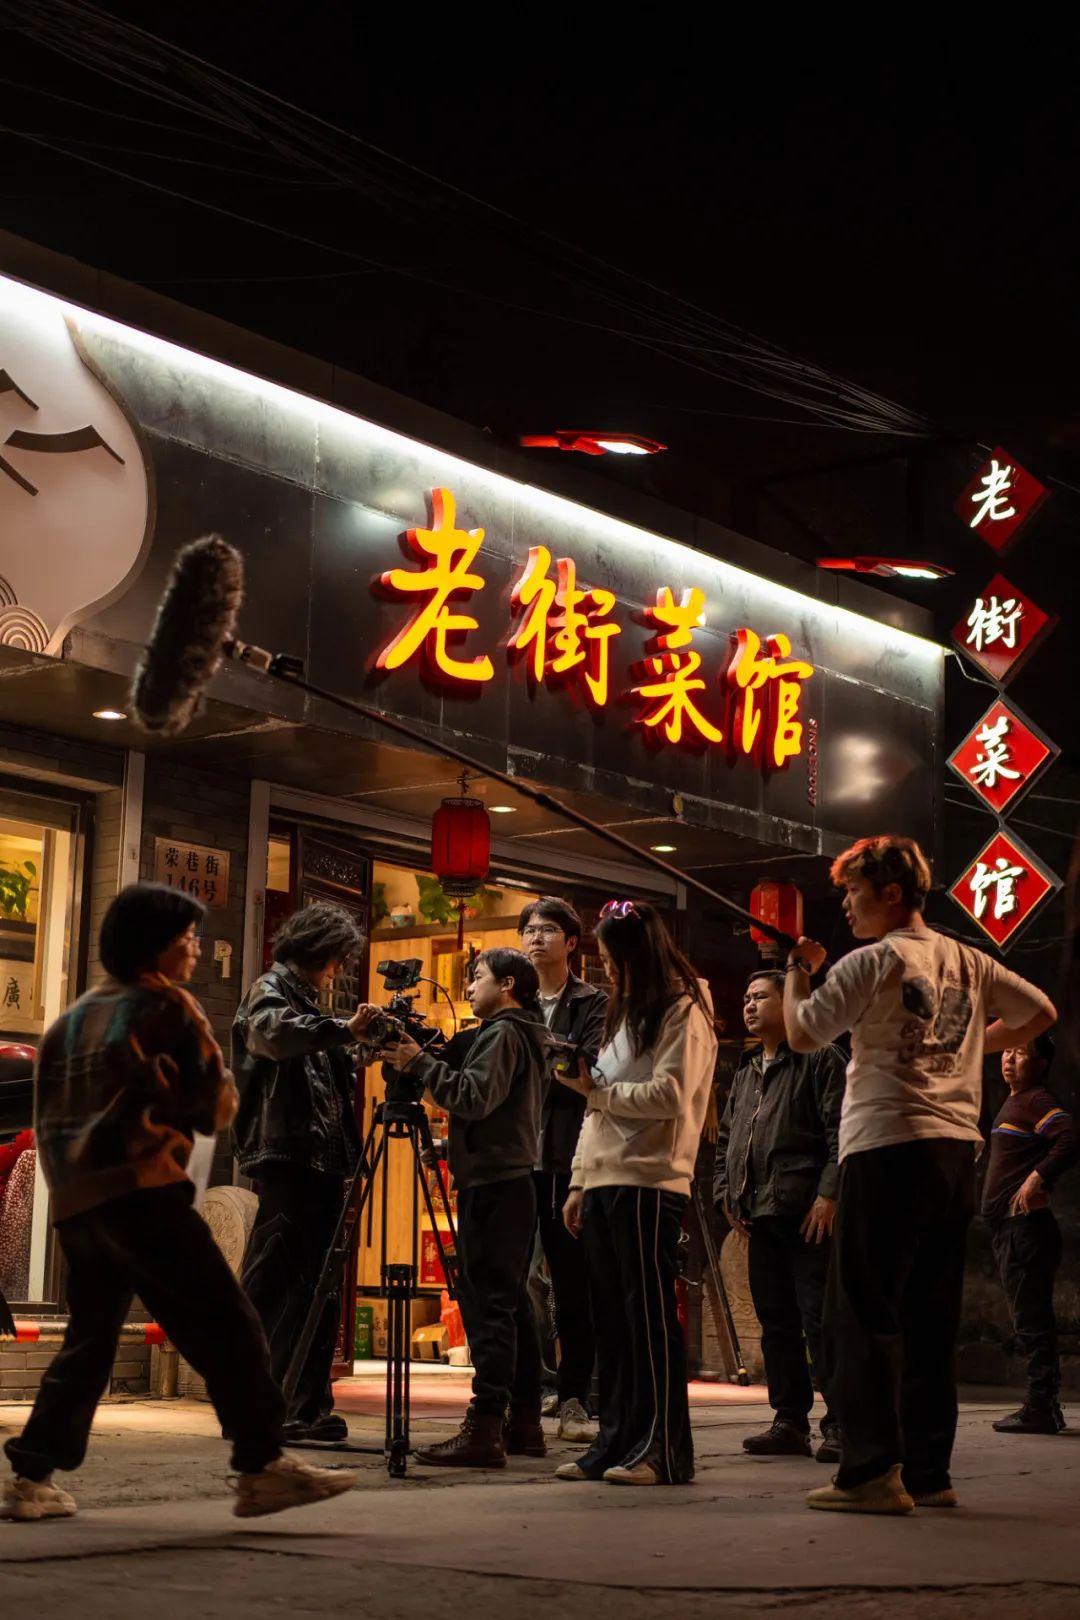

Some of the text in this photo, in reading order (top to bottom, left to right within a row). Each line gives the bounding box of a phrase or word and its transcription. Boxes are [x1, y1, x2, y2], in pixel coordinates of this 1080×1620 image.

[376, 487, 814, 767] 老街菜馆
[966, 459, 1024, 920] 老街菜馆
[808, 718, 818, 766] SINCE
[165, 847, 220, 876] 荣巷街
